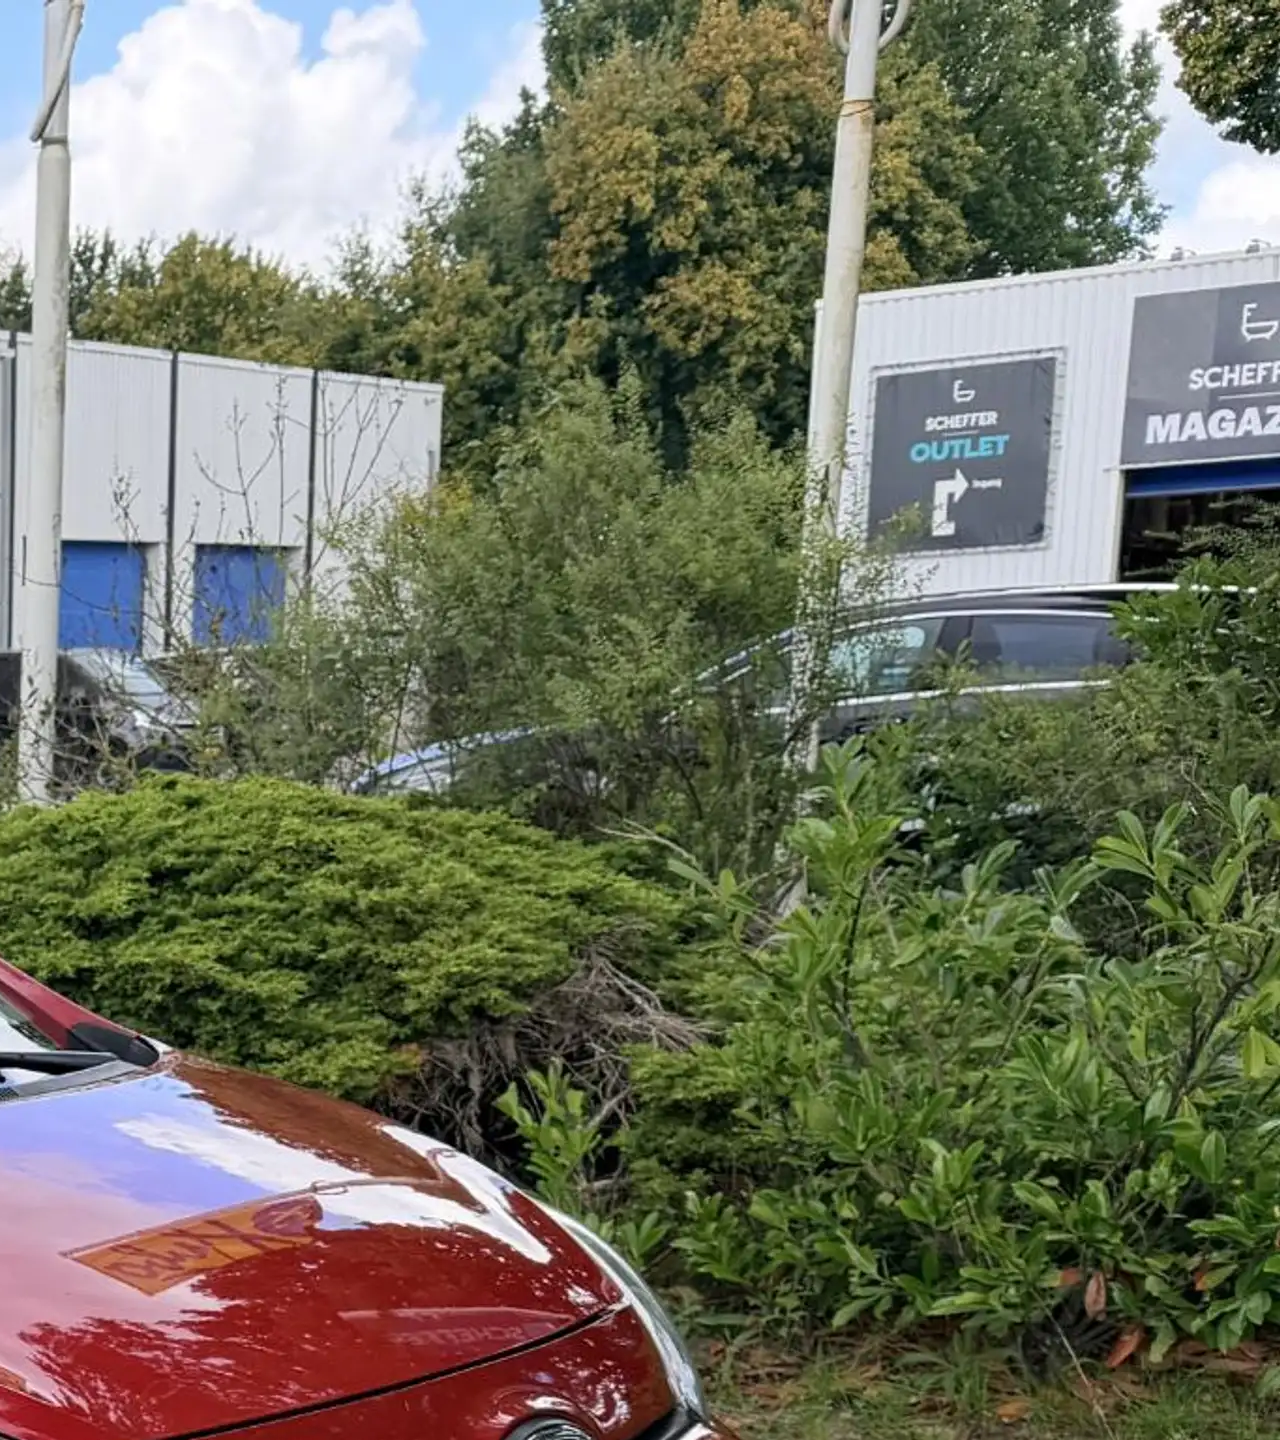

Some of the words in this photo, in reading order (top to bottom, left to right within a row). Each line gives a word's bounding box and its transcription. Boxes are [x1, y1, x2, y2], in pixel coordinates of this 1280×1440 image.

[924, 411, 998, 432] SCHEFFER
[1145, 405, 1280, 444] MAGAZ
[910, 434, 1010, 463] OUTLET
